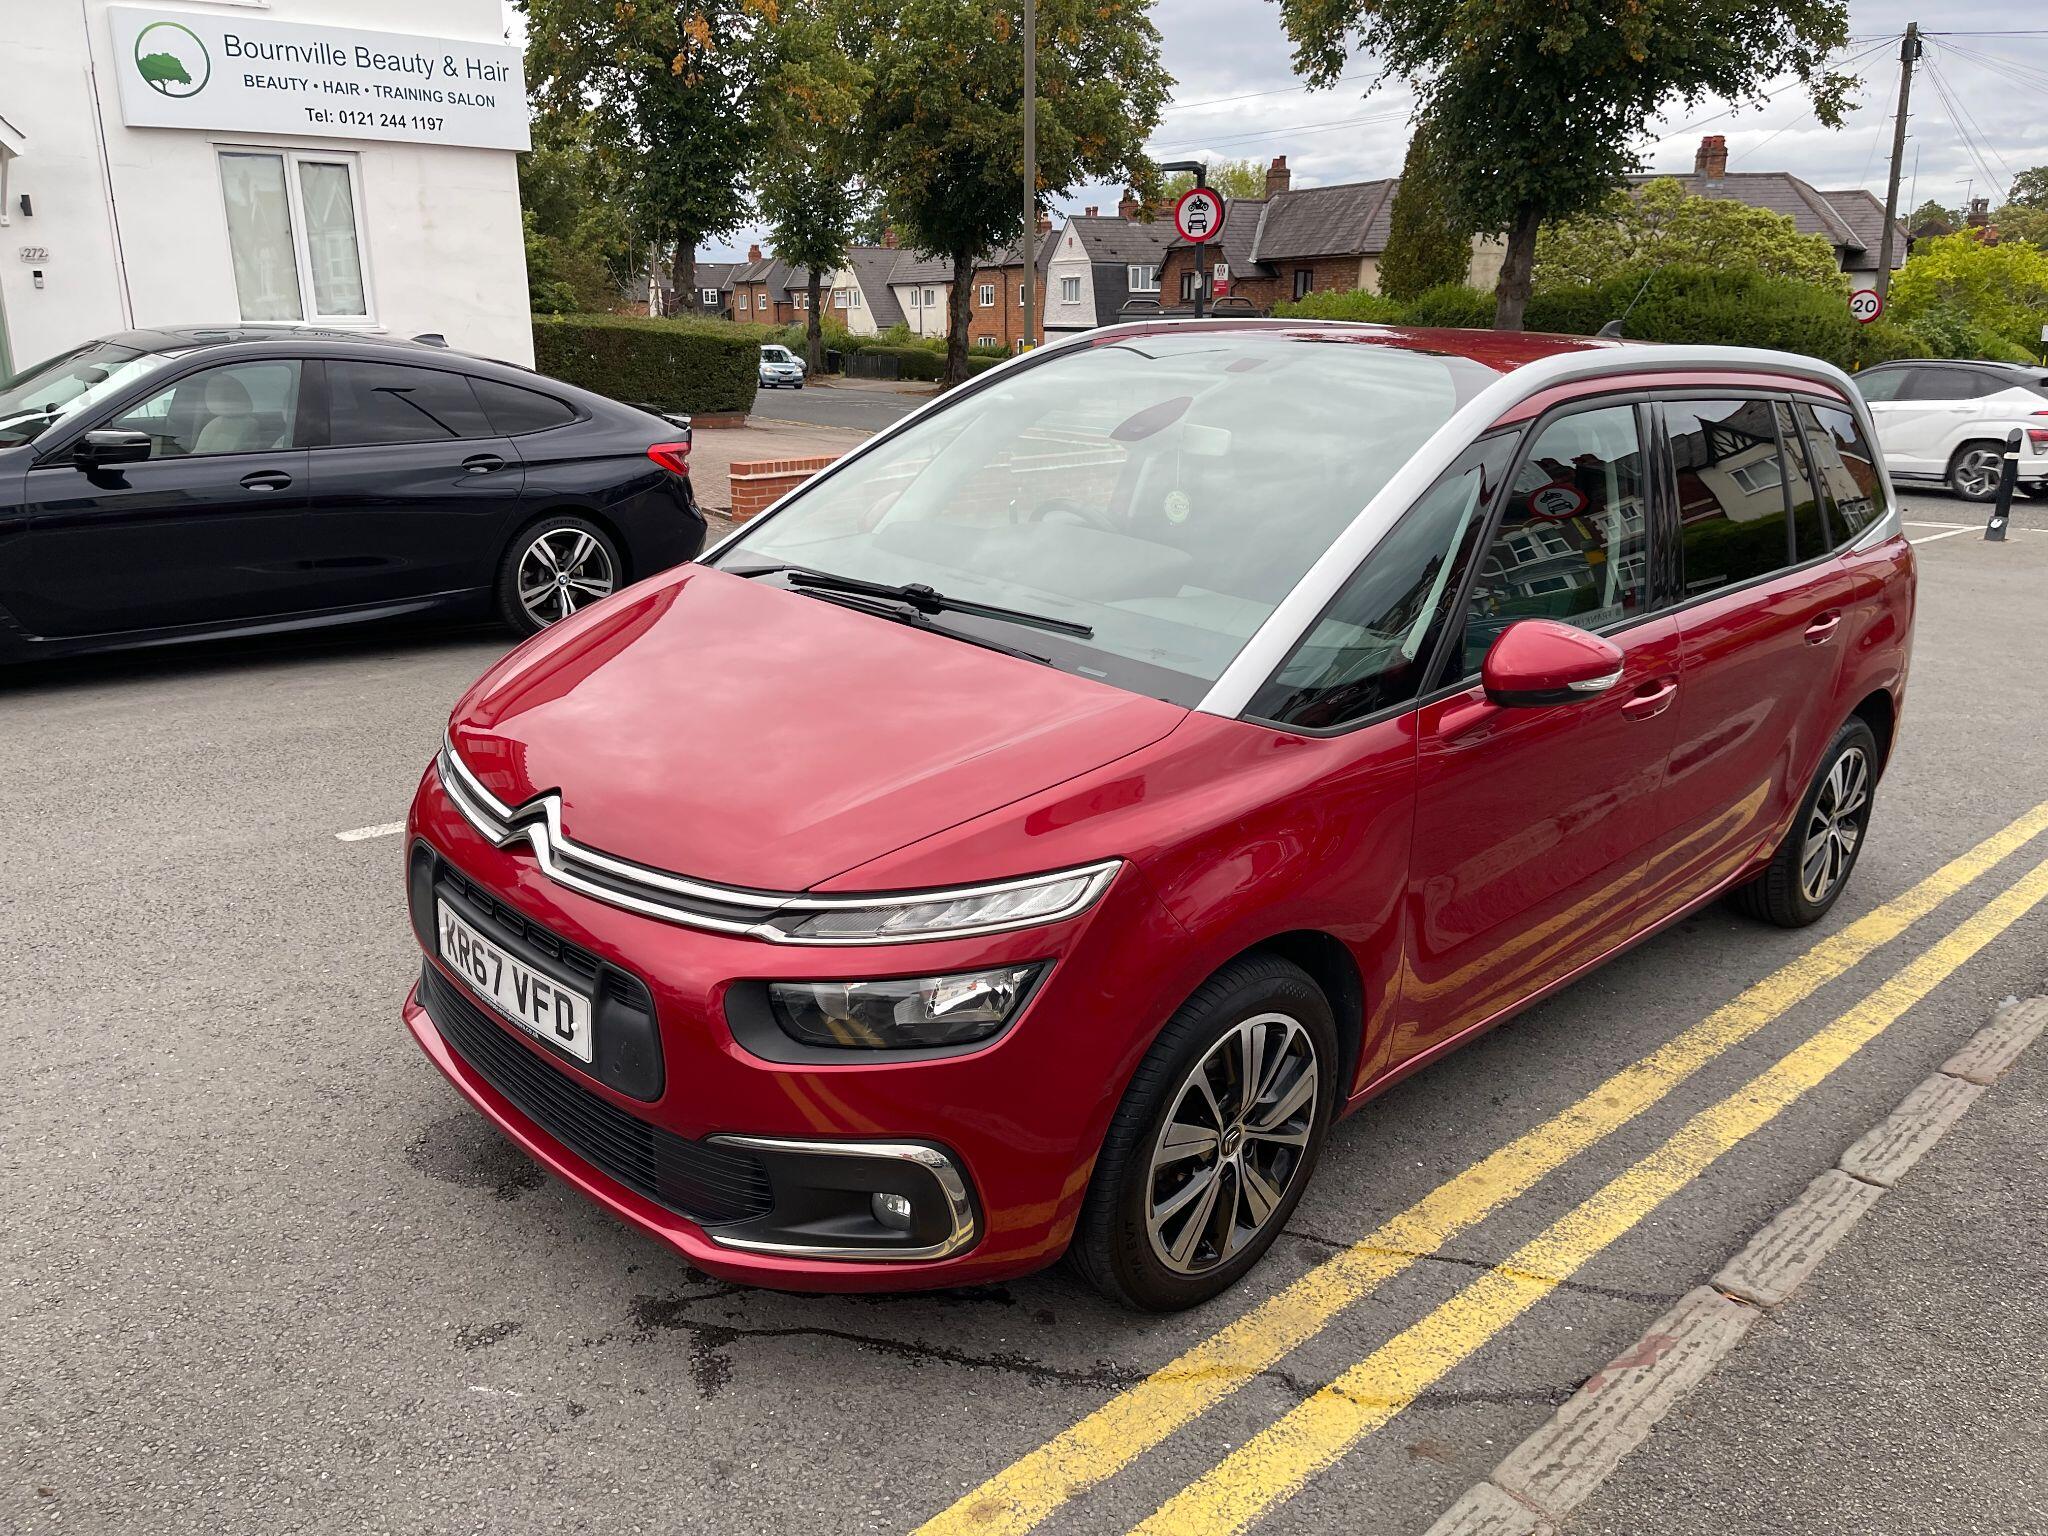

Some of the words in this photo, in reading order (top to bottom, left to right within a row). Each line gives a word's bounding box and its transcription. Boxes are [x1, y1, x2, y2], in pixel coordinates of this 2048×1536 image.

[224, 33, 347, 67] Bournville
[355, 46, 435, 80] Beauty
[443, 55, 459, 78] &
[466, 57, 510, 82] Hair
[243, 74, 309, 91] BEAUTY
[323, 80, 361, 96] HAIR
[373, 85, 443, 103] TRAINING
[447, 91, 496, 108] SALON
[305, 107, 334, 123] Tel:
[339, 110, 374, 126] 0121
[380, 113, 407, 128] 244
[411, 116, 444, 131] 1197
[24, 248, 45, 257] 272
[1852, 299, 1877, 313] 20
[445, 912, 503, 996] KR67
[512, 964, 574, 1042] VFD
